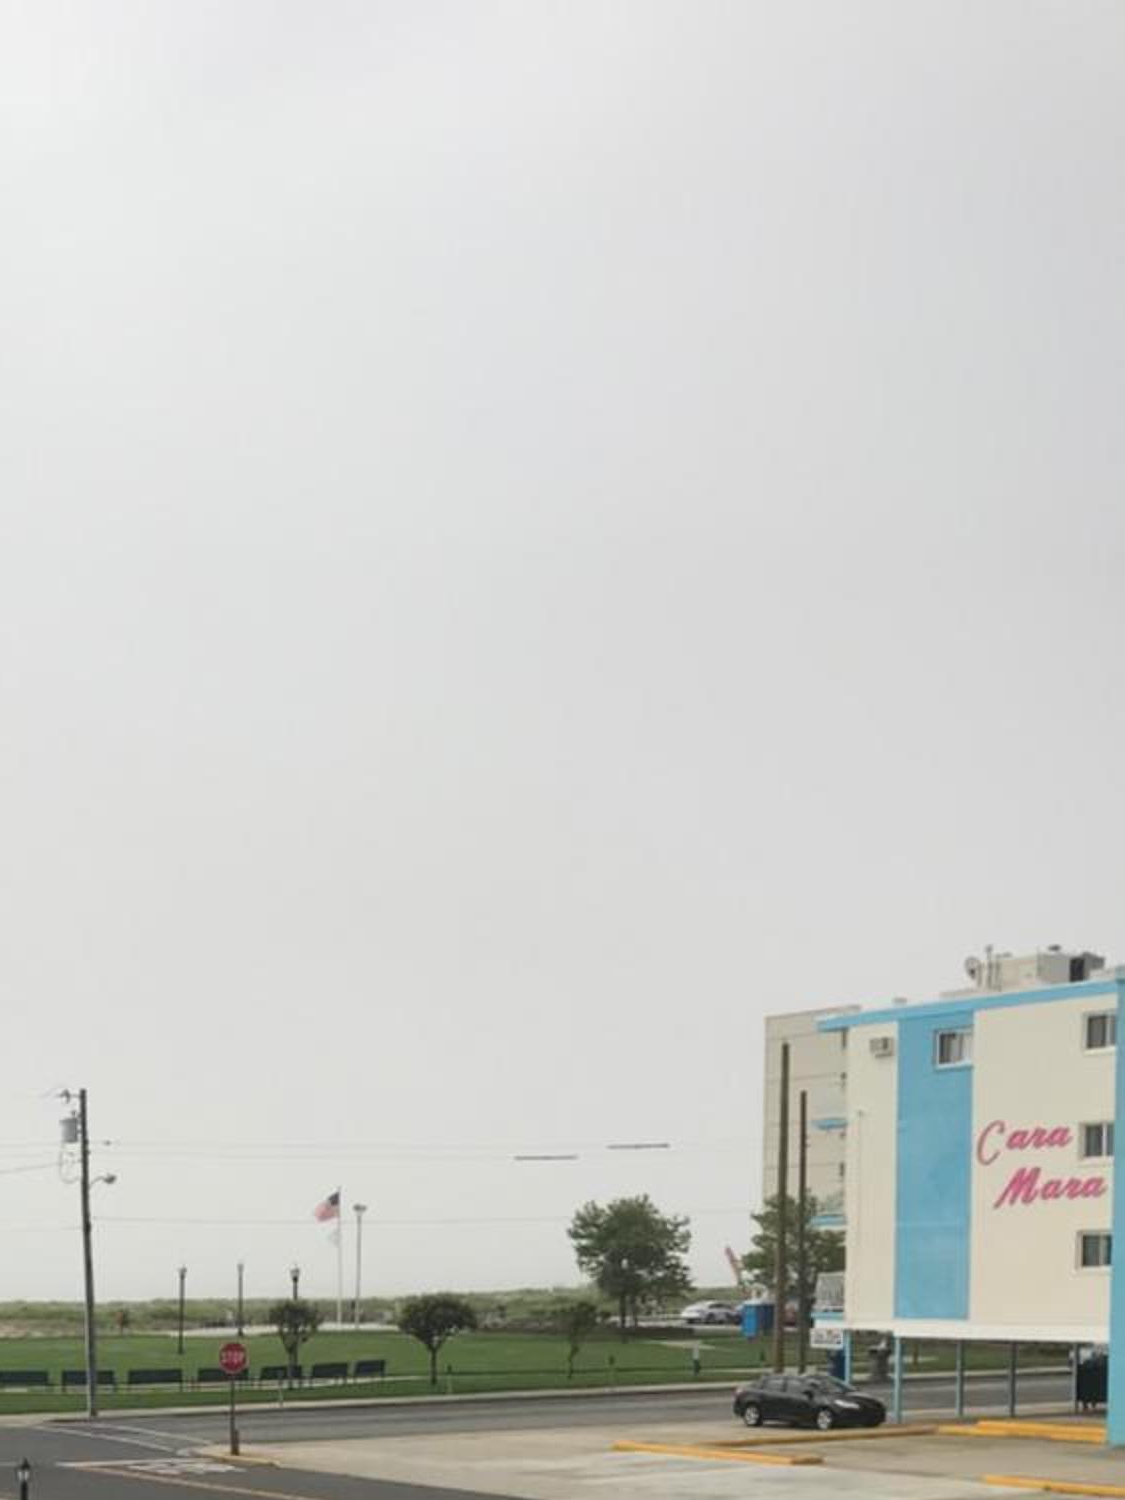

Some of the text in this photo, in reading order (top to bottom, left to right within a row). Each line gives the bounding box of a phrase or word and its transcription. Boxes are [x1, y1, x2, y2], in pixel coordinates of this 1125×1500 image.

[977, 1120, 1073, 1166] Cara
[993, 1167, 1109, 1210] Mara
[221, 1350, 245, 1365] STOP
